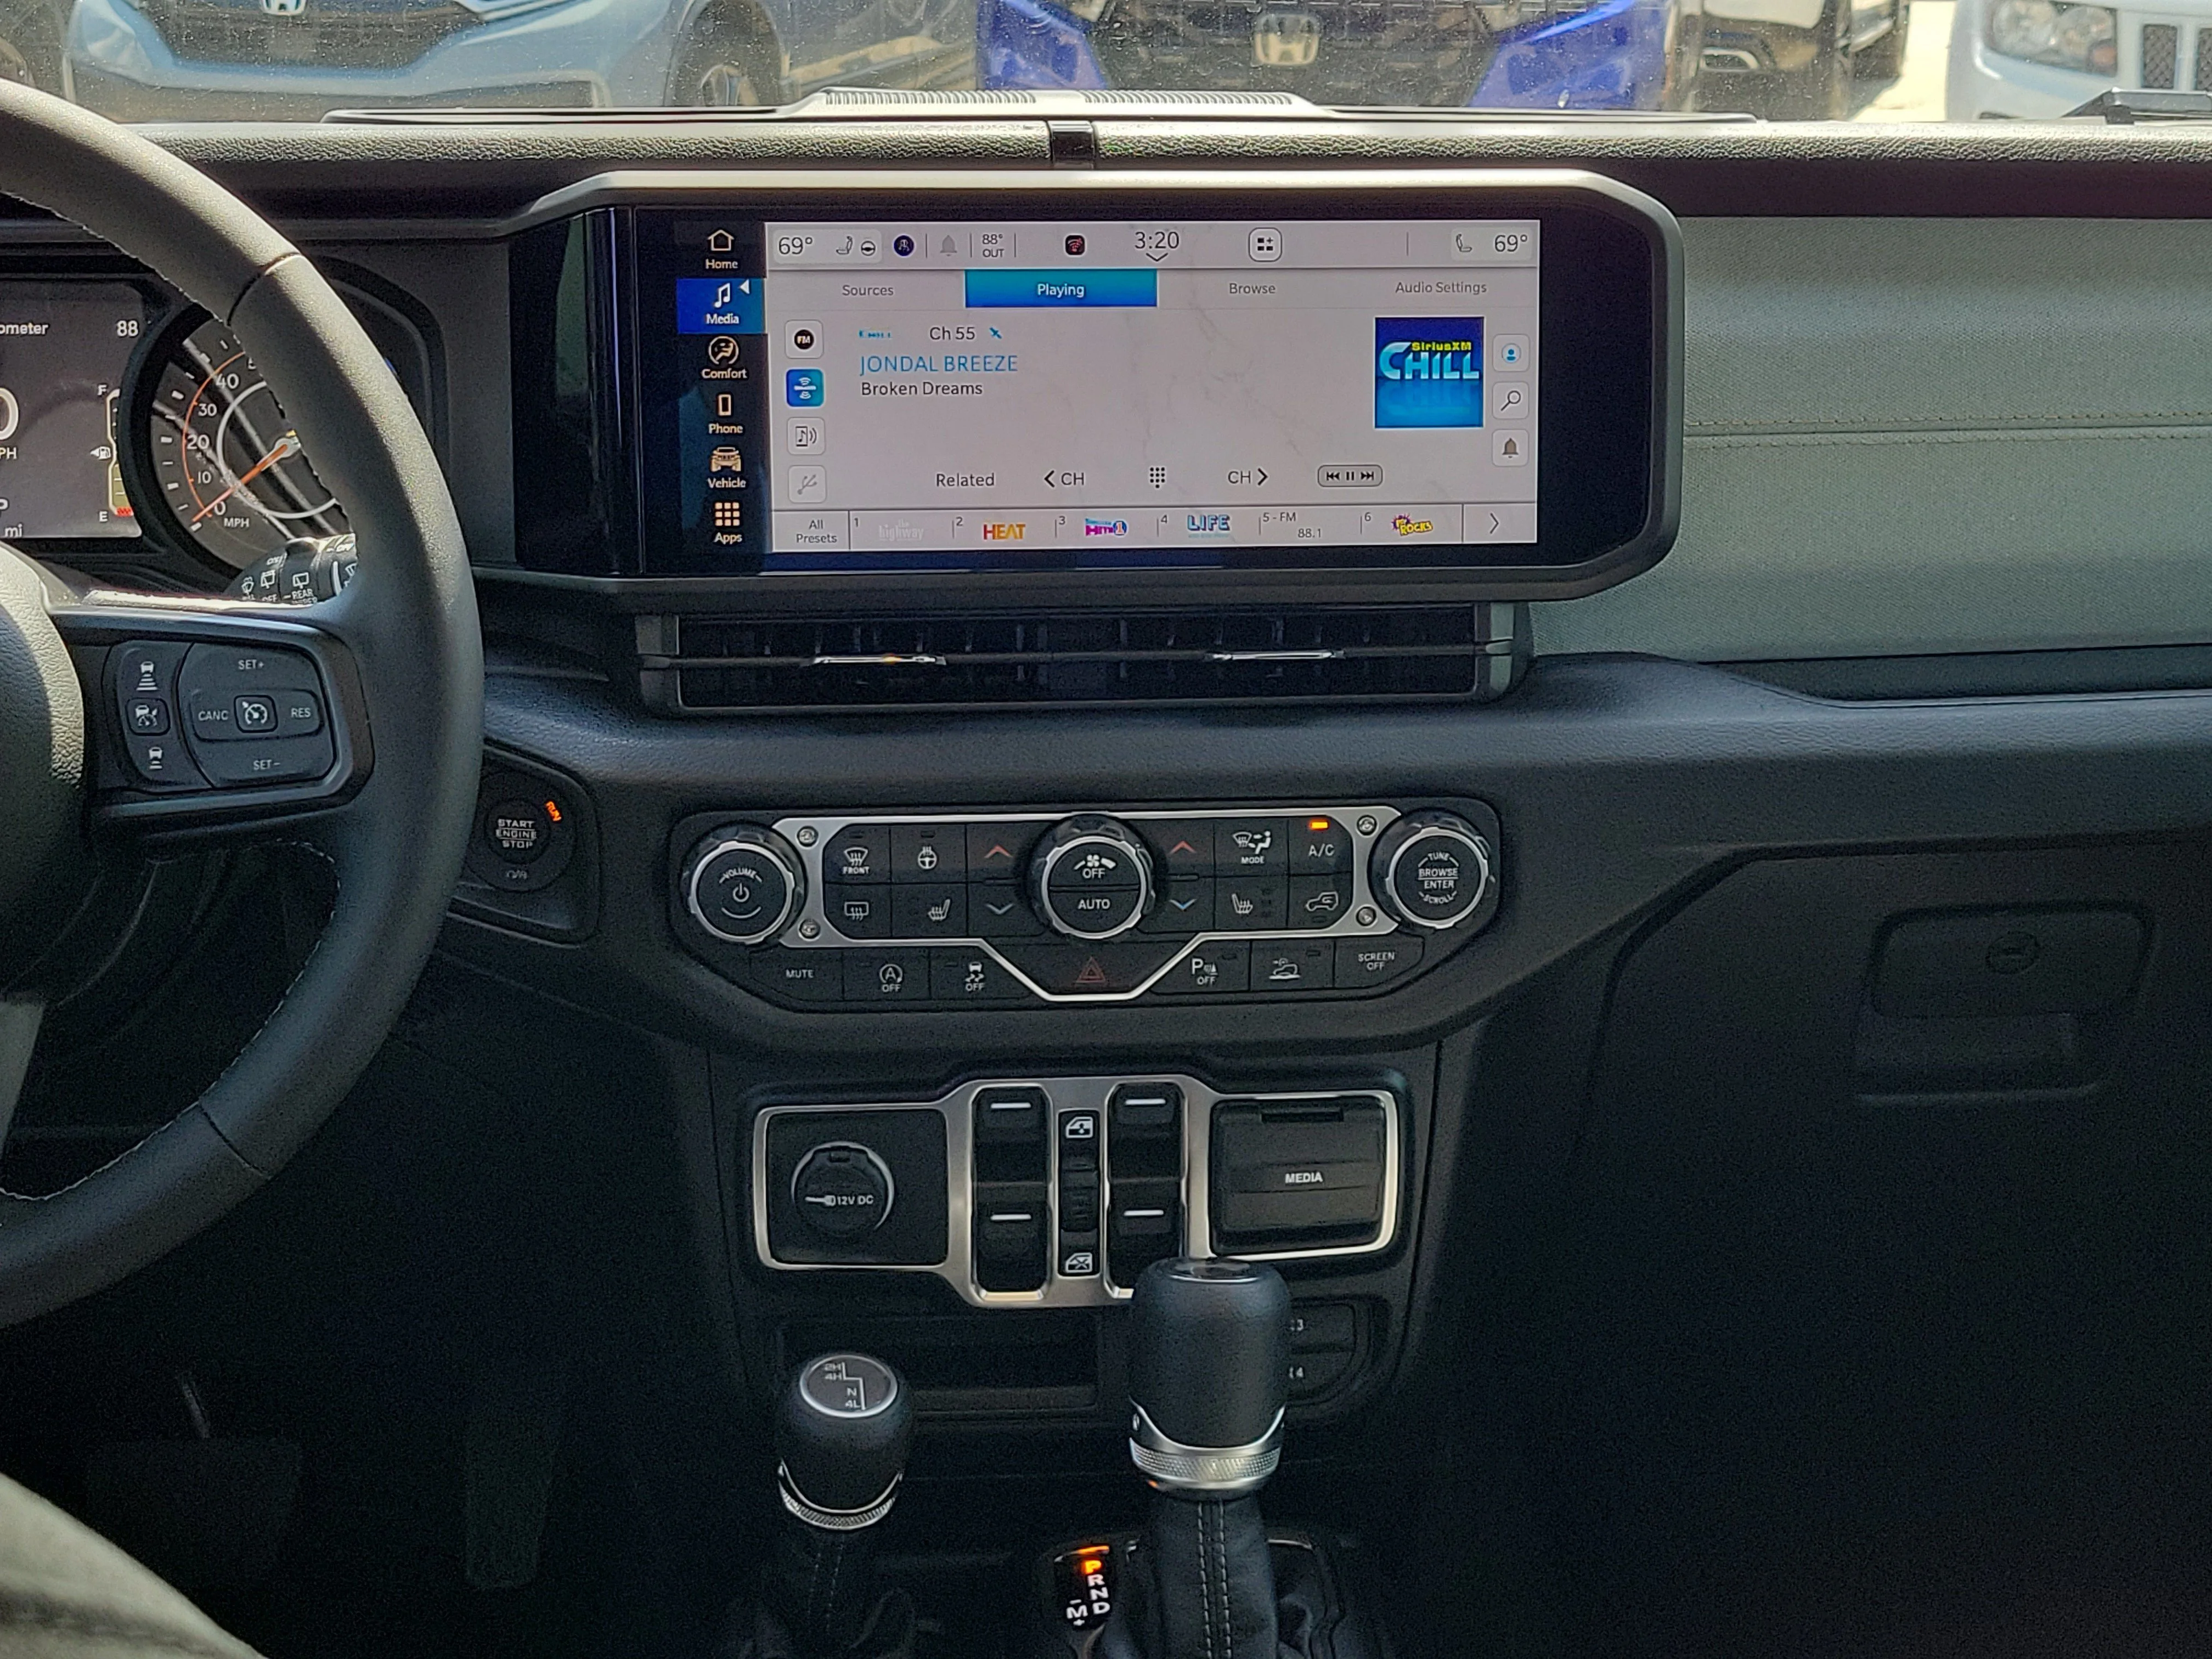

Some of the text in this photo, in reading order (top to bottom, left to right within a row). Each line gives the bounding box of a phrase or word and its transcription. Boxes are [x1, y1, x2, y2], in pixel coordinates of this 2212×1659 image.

[981, 234, 1003, 245] 88°
[1134, 231, 1180, 250] 3:20
[1494, 234, 1528, 252] 69°
[778, 236, 814, 255] 69°
[982, 249, 1005, 258] OUT
[706, 259, 738, 269] Home
[842, 285, 894, 297] Sources
[1037, 284, 1085, 298] Playing
[1229, 283, 1276, 295] Browse
[1395, 281, 1487, 296] Audio Settings
[706, 314, 739, 324] Media
[117, 320, 138, 336] 88
[930, 326, 975, 340] Ch 55
[1412, 341, 1471, 351] SiriusXM
[860, 356, 1018, 376] JONDAL BREEZE
[1380, 341, 1480, 380] CHILL
[702, 368, 747, 379] Comfort
[216, 373, 239, 389] 40
[98, 385, 107, 396] F
[862, 382, 983, 396] Broken Dreams
[198, 403, 217, 416] 30
[709, 424, 743, 434] Phone
[187, 434, 210, 450] 20
[198, 471, 212, 484] 10
[707, 477, 746, 488] Vehicle
[936, 473, 995, 487] Related
[1061, 473, 1085, 486] CH
[1228, 471, 1251, 483] CH
[99, 511, 108, 522] E
[854, 517, 859, 527] 1
[956, 517, 963, 526] 2
[1058, 516, 1065, 526] 3
[1160, 515, 1167, 524] 4
[1263, 514, 1269, 522] 5
[1280, 513, 1296, 521] FM
[1365, 512, 1371, 521] 6
[224, 518, 250, 528] MPH
[809, 520, 823, 530] All
[1187, 514, 1231, 531] LIFE
[4, 523, 23, 537] mi
[984, 523, 1025, 540] HEAT
[1298, 528, 1322, 538] 88.1
[714, 533, 742, 544] Apps
[796, 533, 837, 544] Presets
[292, 589, 313, 599] REAR
[199, 711, 228, 721] CANC
[291, 708, 311, 718] RES
[498, 819, 535, 828] START
[495, 829, 537, 839] ENGINE
[502, 840, 533, 848] STOP
[1308, 843, 1334, 856] A/C
[1427, 852, 1449, 861] TUNE
[723, 867, 757, 879] VOLUME
[1082, 868, 1105, 878] OFF
[1418, 868, 1458, 877] BROWSE
[1424, 880, 1454, 889] ENTER
[1078, 899, 1110, 910] AUTO
[1358, 952, 1395, 962] SCREEN
[1367, 962, 1385, 970] OFF
[786, 969, 814, 978] MUTE
[1197, 976, 1215, 985] OFF
[965, 983, 985, 991] OFF
[1285, 1172, 1323, 1183] MEDIA
[837, 1195, 873, 1205] 12V DC
[847, 1387, 857, 1396] N
[845, 1400, 860, 1408] 4L
[1085, 1560, 1102, 1574] P
[1087, 1574, 1105, 1587] R
[1090, 1587, 1109, 1600] N
[1066, 1605, 1088, 1619] M
[1093, 1601, 1110, 1615] D
